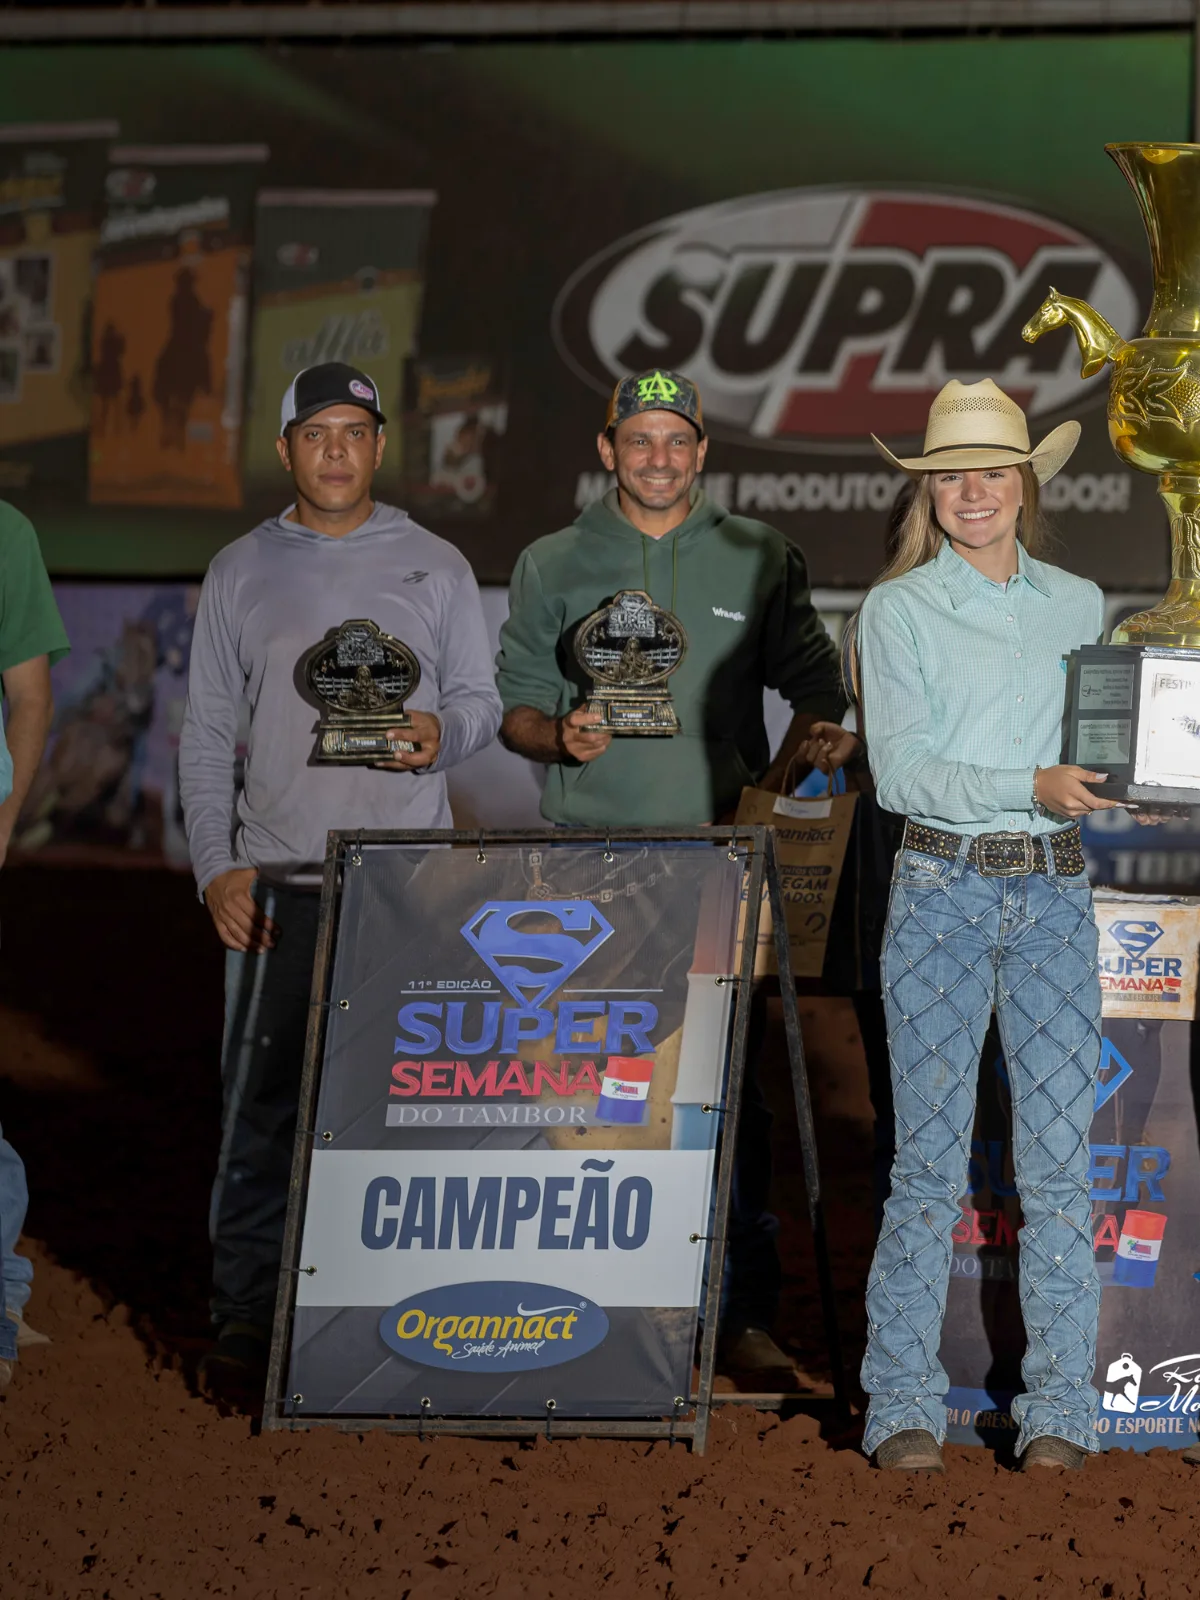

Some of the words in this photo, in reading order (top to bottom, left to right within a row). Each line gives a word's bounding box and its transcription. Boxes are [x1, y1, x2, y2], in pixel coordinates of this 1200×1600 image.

[613, 258, 1106, 375] SUPRA
[737, 471, 908, 513] PRODUTO
[436, 978, 492, 991] EDIÇÃO
[1100, 977, 1164, 992] EMANA
[394, 1001, 659, 1055] SUPER
[389, 1060, 603, 1097] SEMANA
[398, 1106, 443, 1124] DO
[452, 1105, 588, 1124] TAMBOR
[360, 1158, 653, 1250] CAMPEÃO
[396, 1309, 579, 1356] Organnact
[494, 1339, 545, 1358] Animal
[1115, 1417, 1184, 1434] ESPORTE
